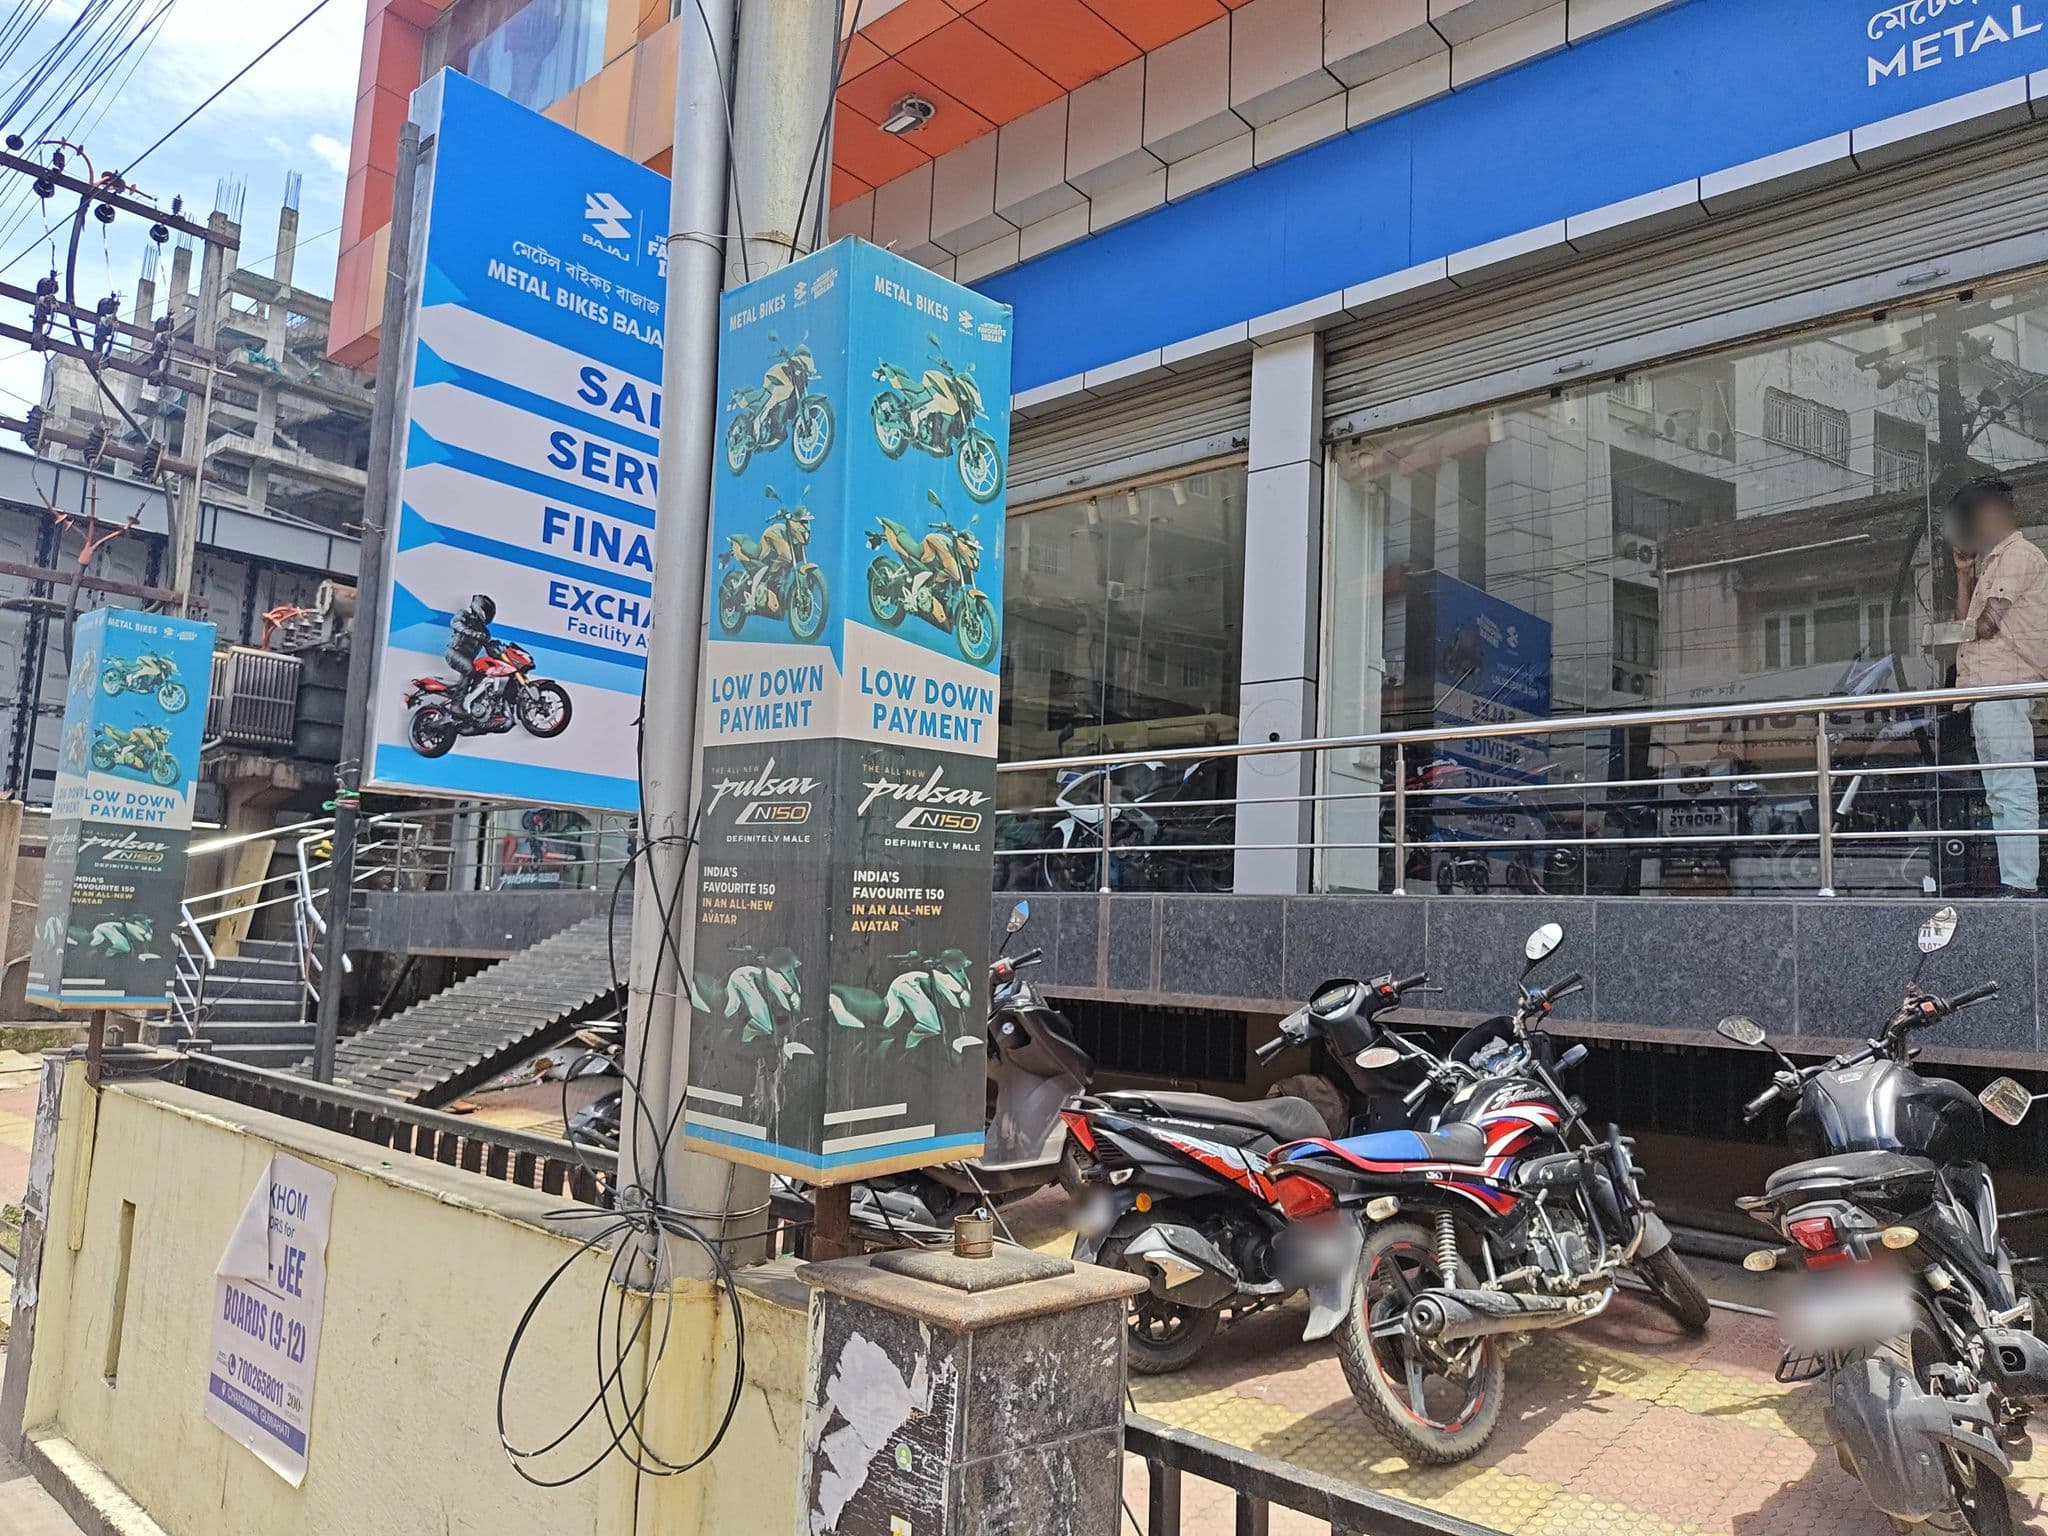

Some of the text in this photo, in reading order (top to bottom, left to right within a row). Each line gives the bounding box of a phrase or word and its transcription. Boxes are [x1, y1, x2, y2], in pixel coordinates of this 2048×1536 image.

[1868, 4, 2043, 87] METAL
[582, 233, 630, 262] BAJAJ
[488, 258, 551, 302] METAL
[556, 287, 609, 325] BIKES
[874, 274, 913, 307] METAL
[916, 294, 949, 322] BIKES
[729, 293, 786, 332] METAL BIKES
[108, 617, 134, 631] METAL
[135, 623, 158, 635] BIKES
[568, 616, 632, 648] Facility
[712, 664, 824, 703] LOW DOWN
[861, 666, 993, 715] LOW DOWN
[720, 700, 812, 734] PAYMENT
[872, 702, 983, 744] PAYMENT
[862, 763, 881, 774] THE
[706, 756, 823, 817] pulsar
[857, 765, 992, 817] pulsar
[84, 789, 176, 809] LOW DOWN
[90, 804, 166, 823] PAYMENT
[754, 805, 807, 820] N150
[919, 812, 977, 830] N150
[78, 831, 170, 854] pulsar
[726, 835, 811, 843] DEFINITELY MALE
[884, 838, 981, 852] DEFINITELY MALE
[703, 866, 738, 878] INDIA'S
[853, 870, 900, 883] INDIA'S
[703, 881, 776, 896] FAVOURITE 150
[852, 886, 945, 901] FAVOURITE 150
[702, 897, 774, 912] IN AN ALL-NEW
[852, 904, 942, 916] IN AN ALL-NEW
[702, 912, 738, 925] AVATAR
[851, 920, 899, 932] AVATAR
[284, 1221, 296, 1239] for
[277, 1244, 306, 1299] JEE
[223, 1284, 307, 1364] BOARDS (9-12)
[237, 1356, 284, 1408] 7002658011
